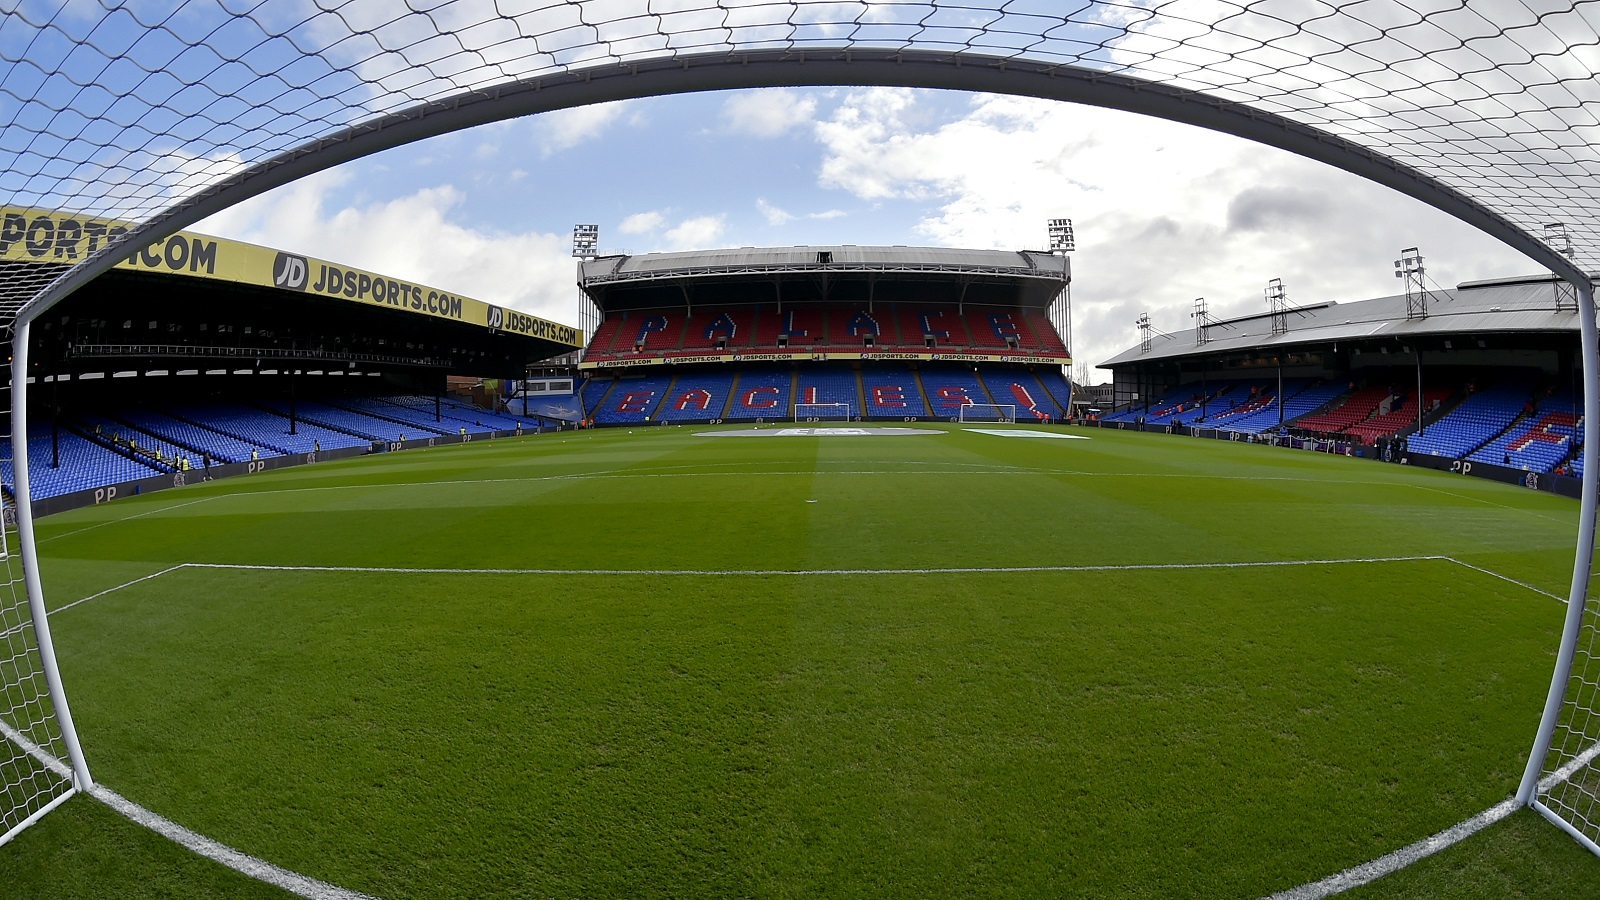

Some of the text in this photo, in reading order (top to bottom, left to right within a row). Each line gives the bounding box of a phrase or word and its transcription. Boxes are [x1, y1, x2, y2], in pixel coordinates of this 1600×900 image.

[276, 256, 462, 319] JD JDSPORTS.COM
[489, 307, 576, 344] JD JDSPORTS.COM
[636, 310, 1021, 342] PALACE
[606, 359, 652, 367] JDSPORTS.COM
[742, 353, 792, 361] JDSPORTS.COM
